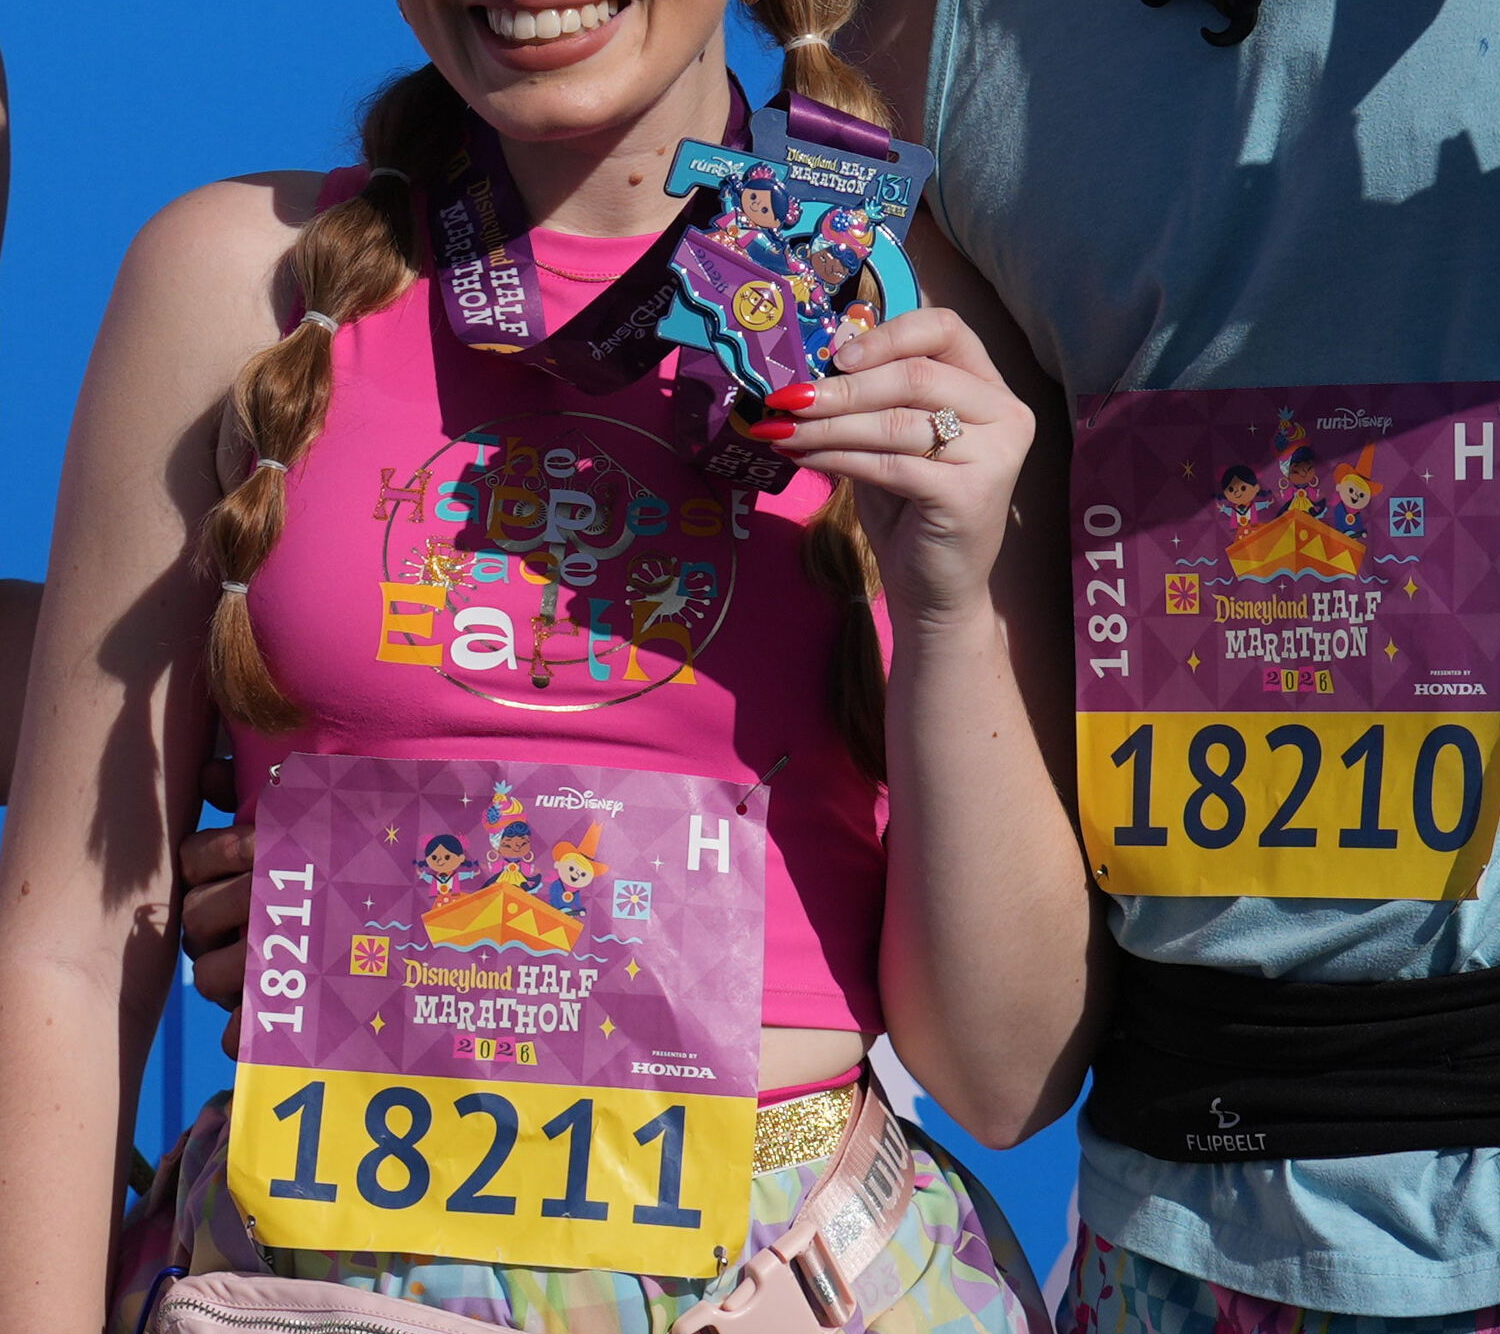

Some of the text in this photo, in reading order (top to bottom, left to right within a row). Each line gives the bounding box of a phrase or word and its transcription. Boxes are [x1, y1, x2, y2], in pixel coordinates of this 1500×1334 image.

[786, 146, 877, 181] Disneyland HALF
[790, 163, 868, 195] MARATHON
[440, 199, 493, 326] MARATHON
[468, 172, 529, 337] Disneyland HALF
[1316, 407, 1393, 433] runDisney
[463, 432, 577, 478] The
[1454, 422, 1495, 481] H
[628, 549, 718, 598] On
[1084, 505, 1130, 678] 18210
[1212, 590, 1382, 625] Disneyland HALF
[376, 581, 698, 685] Earth
[1225, 626, 1369, 663] MARATHON
[1267, 669, 1331, 693] 2026
[1414, 682, 1487, 696] HONDA
[535, 786, 624, 818] runDisney
[1110, 723, 1483, 852] 18210
[687, 814, 730, 873] H
[257, 864, 314, 1033] 18211
[401, 957, 599, 999] Disneyland HALF
[413, 995, 581, 1035] MARATHON
[457, 1039, 532, 1063] 2026
[630, 1062, 717, 1080] HONDA
[652, 1050, 686, 1058] PRESENTED
[269, 1080, 702, 1229] 18211
[1187, 1133, 1267, 1152] FLIPBELT
